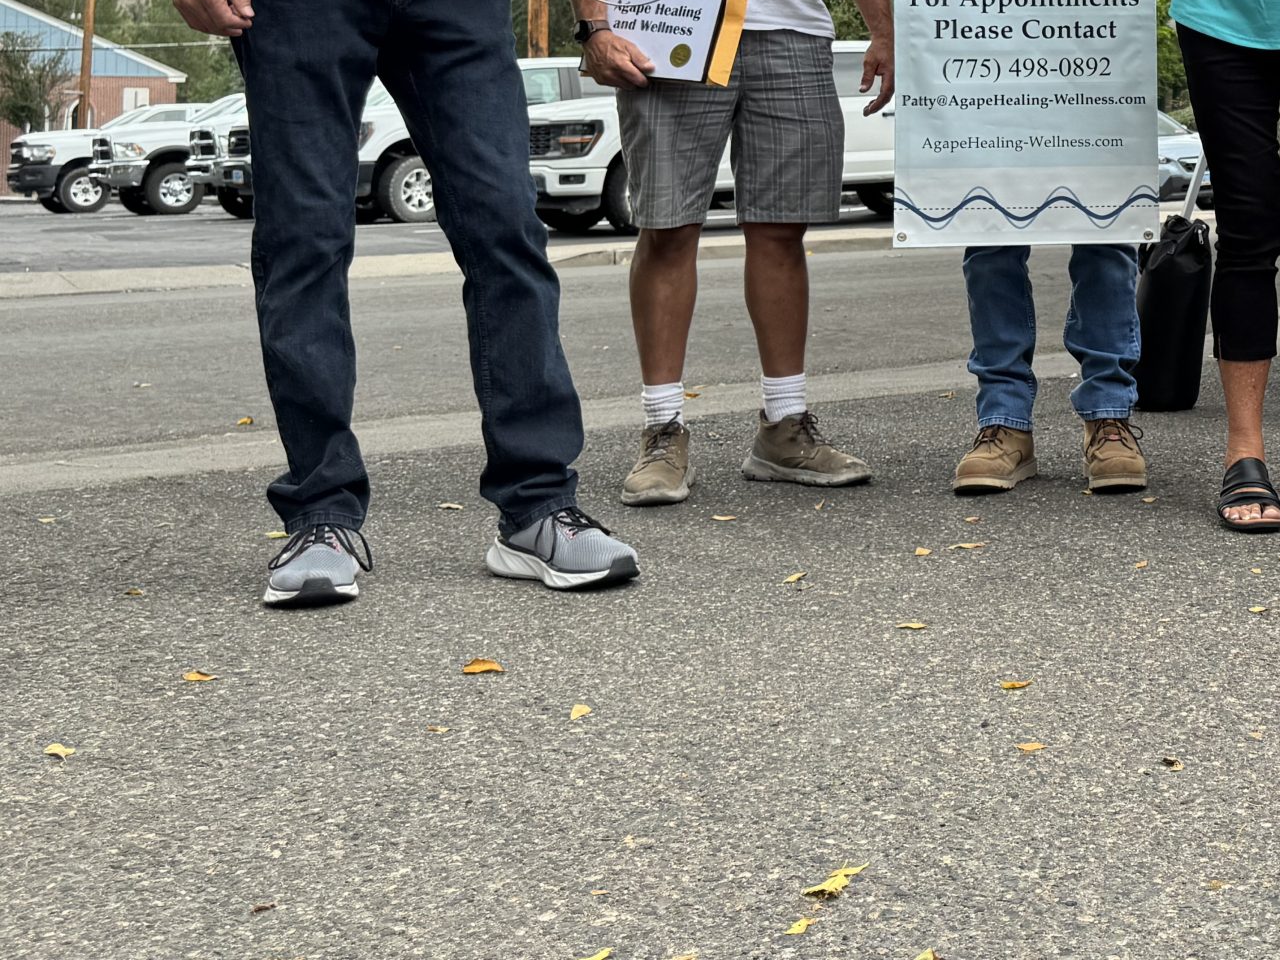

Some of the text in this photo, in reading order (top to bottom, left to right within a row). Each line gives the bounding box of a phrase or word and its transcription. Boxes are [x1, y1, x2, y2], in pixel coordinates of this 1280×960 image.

[613, 0, 703, 22] Agape Healing
[612, 18, 694, 37] and Wellness
[934, 19, 1117, 40] Please Contact
[942, 56, 1112, 84] (775) 498-0892
[901, 93, 1147, 110] Patty@AgapeHealing-Wellness.com
[922, 135, 1124, 153] AgapeHealing-Wellness.com
